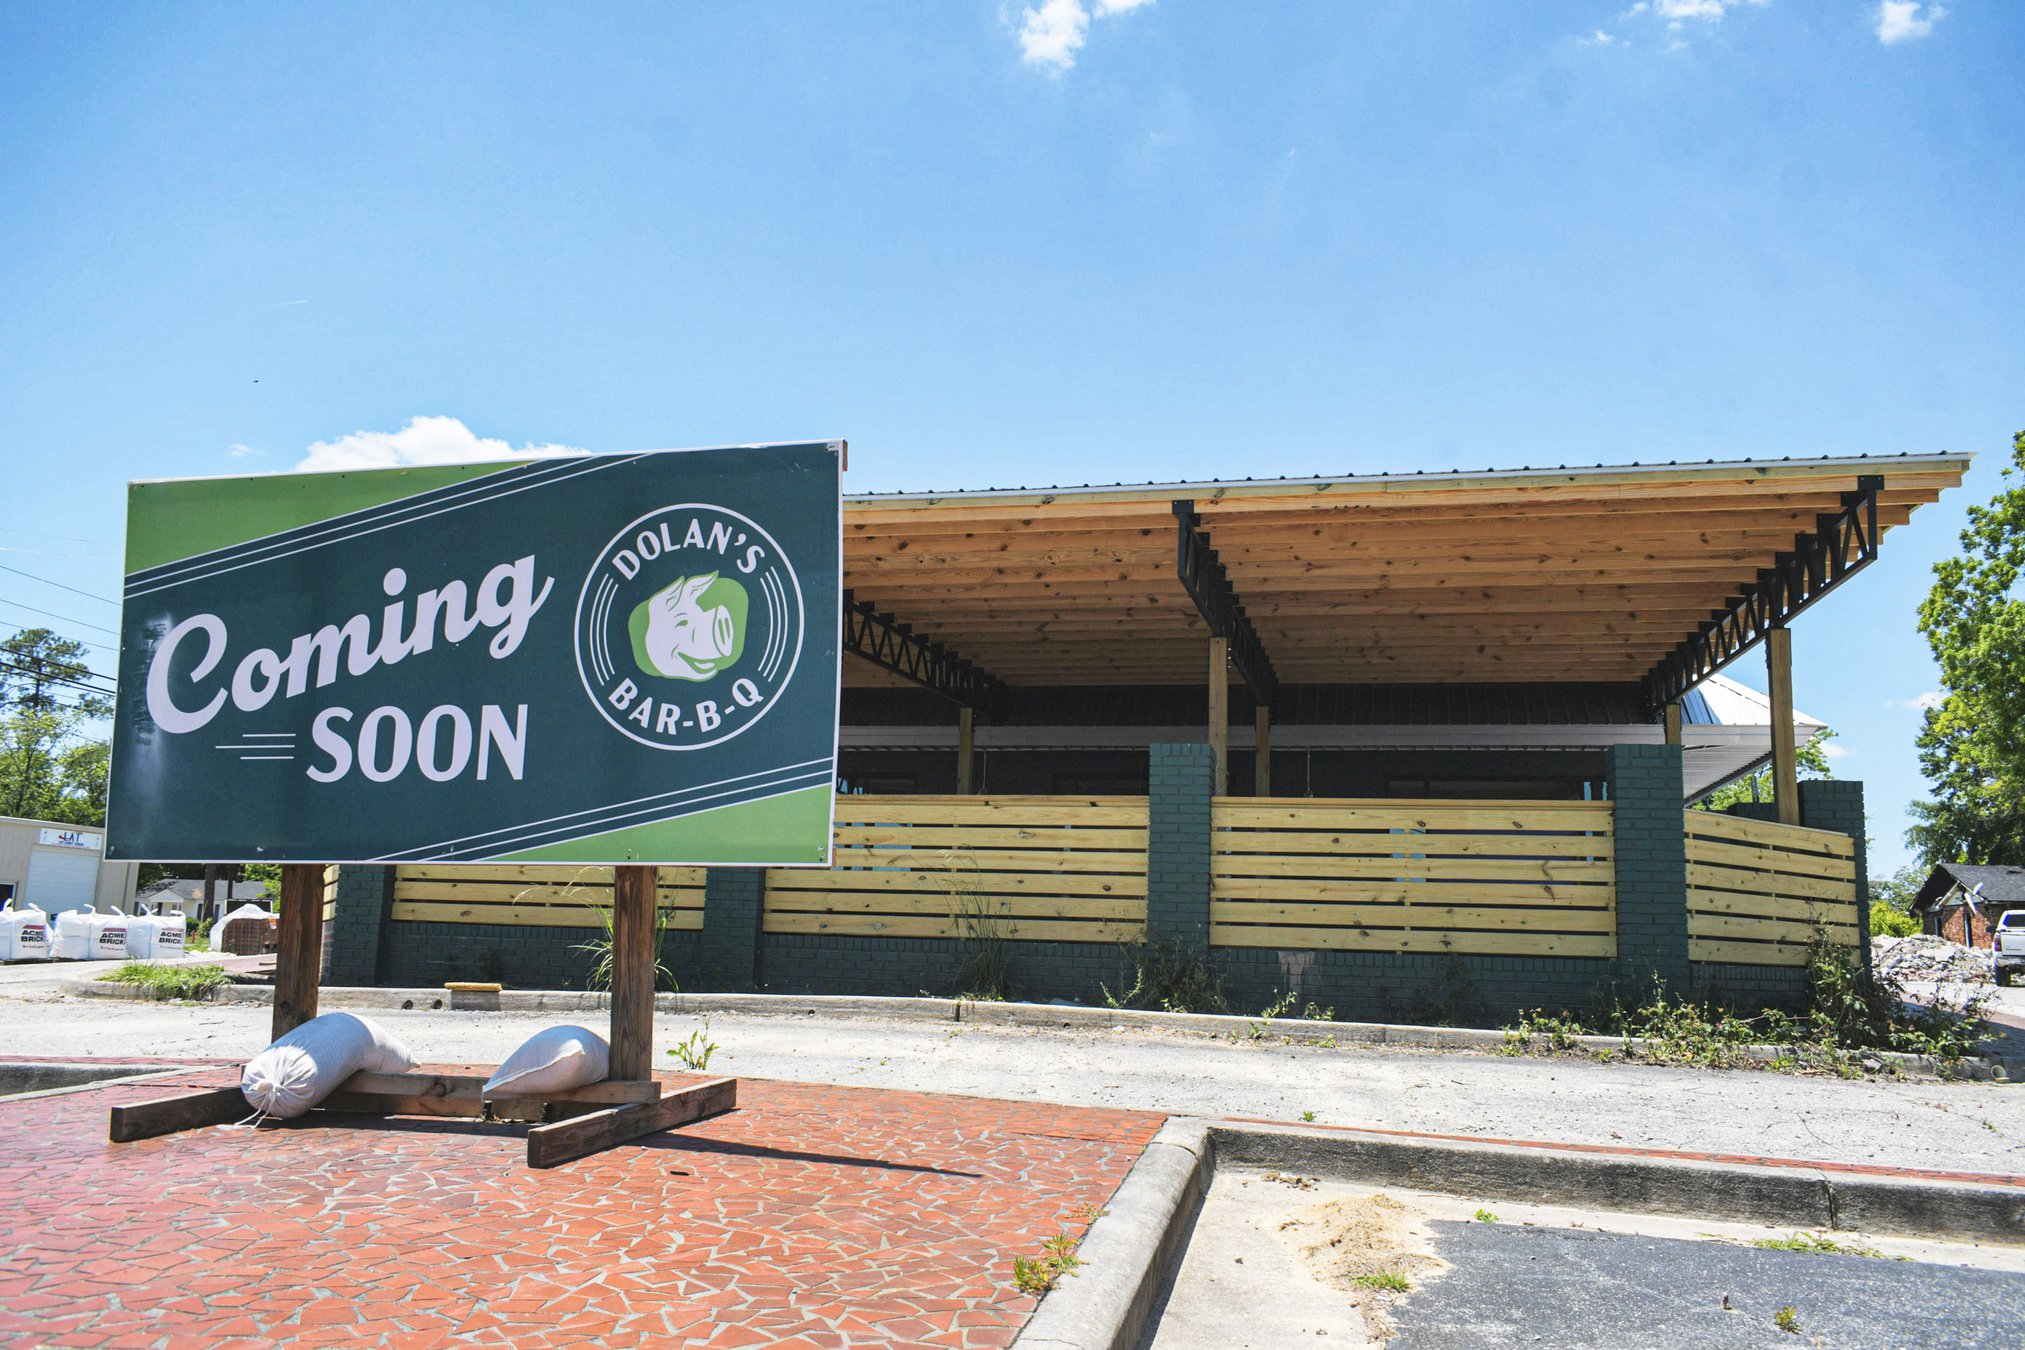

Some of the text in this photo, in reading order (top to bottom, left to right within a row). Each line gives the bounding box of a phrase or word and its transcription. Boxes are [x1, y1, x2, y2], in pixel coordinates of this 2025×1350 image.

[612, 518, 766, 581] DOLAN'S
[146, 554, 555, 734] Coming
[608, 677, 764, 735] BAR-B-Q
[306, 704, 528, 783] SOON
